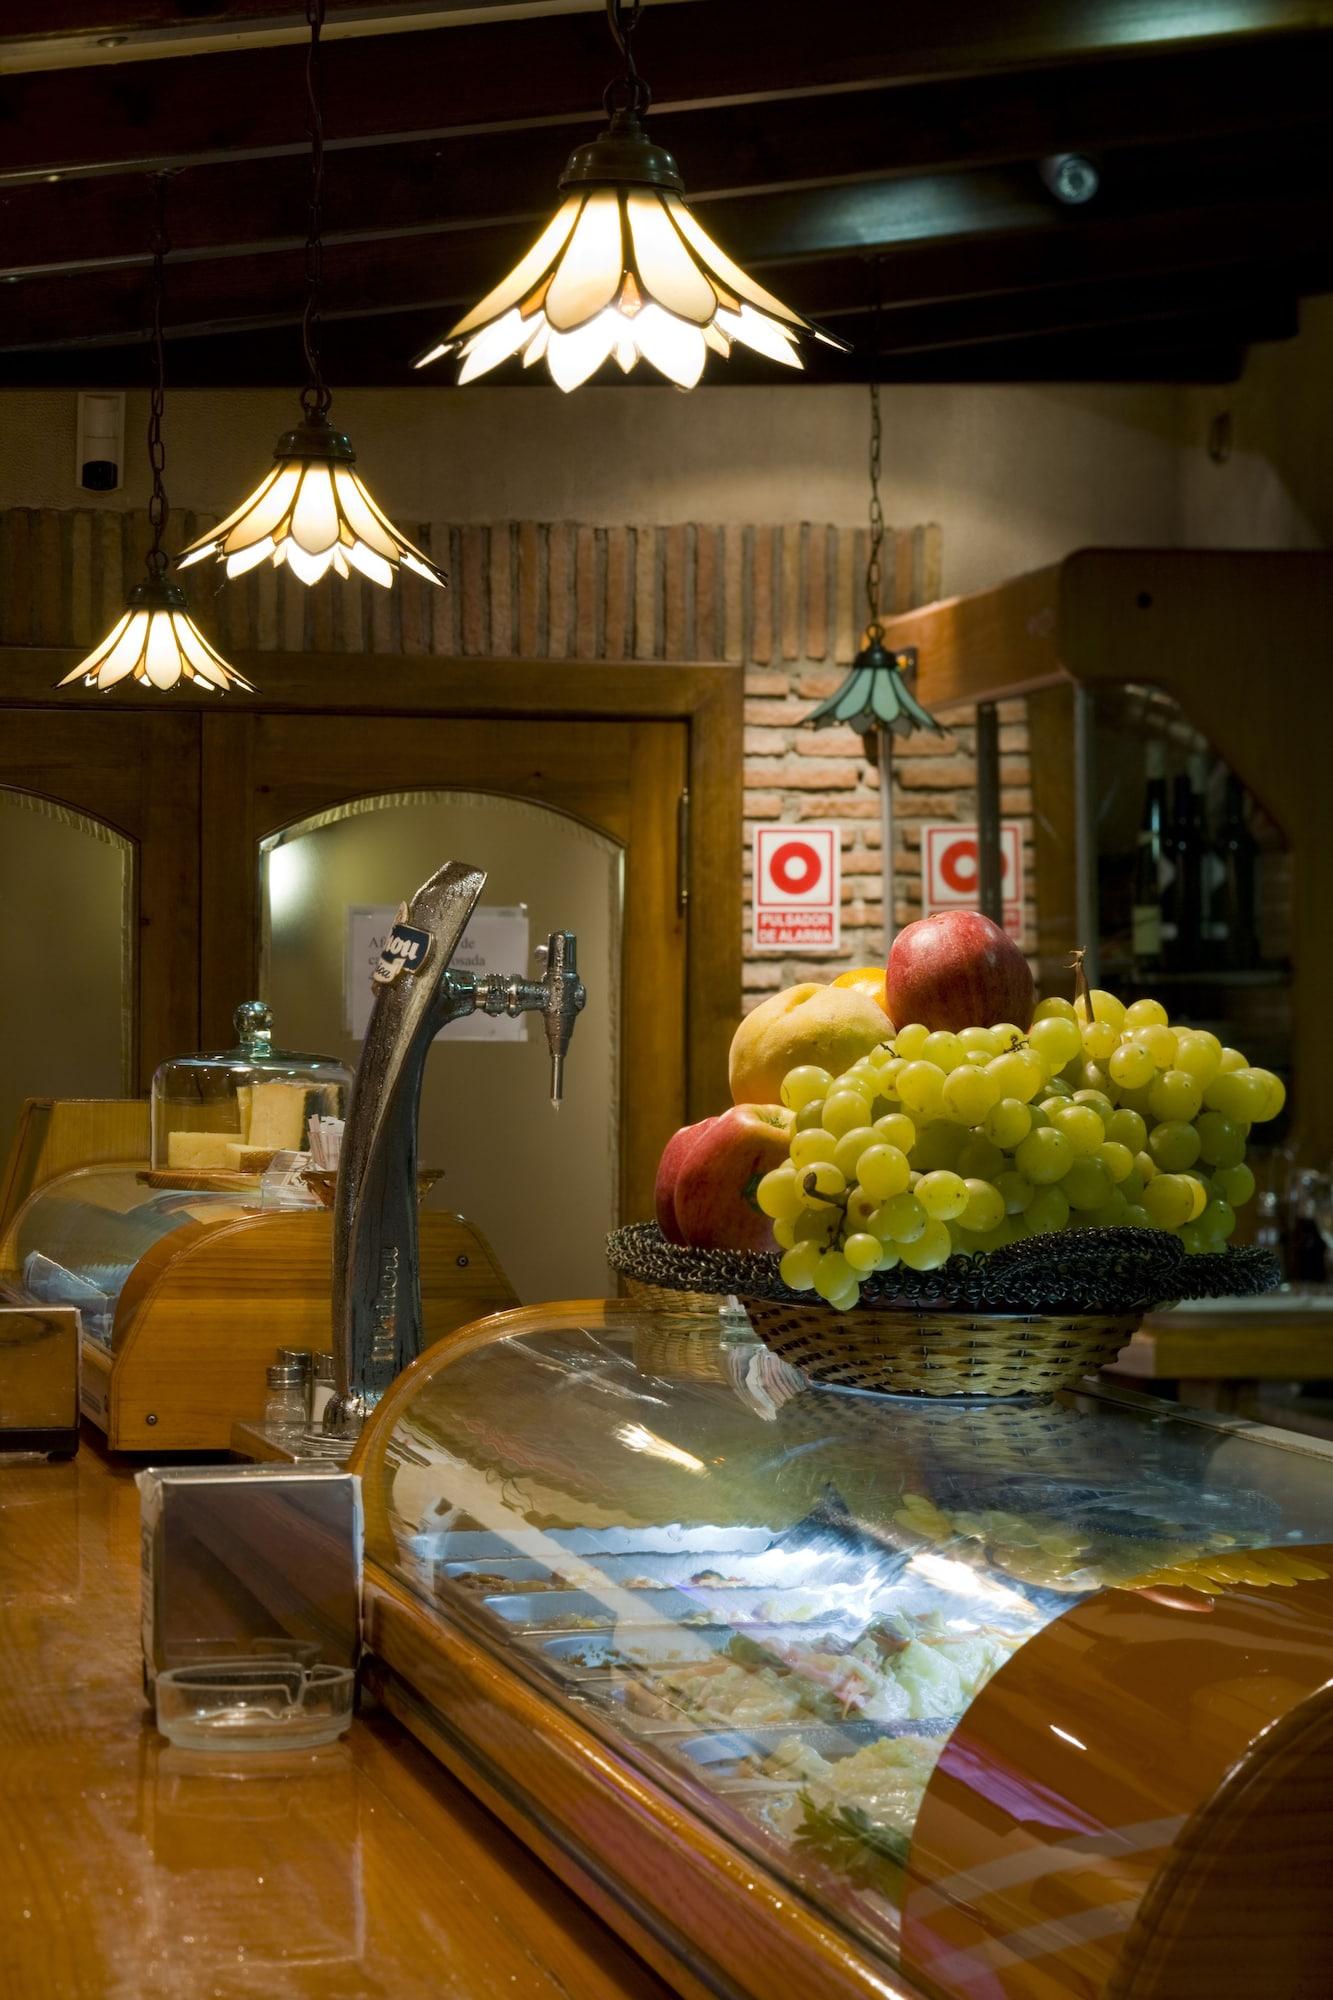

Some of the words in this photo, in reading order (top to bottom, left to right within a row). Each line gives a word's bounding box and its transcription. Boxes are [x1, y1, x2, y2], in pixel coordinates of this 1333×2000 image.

[761, 912, 829, 927] PULSADOR
[758, 928, 776, 943] DE
[778, 928, 832, 943] ALARMA
